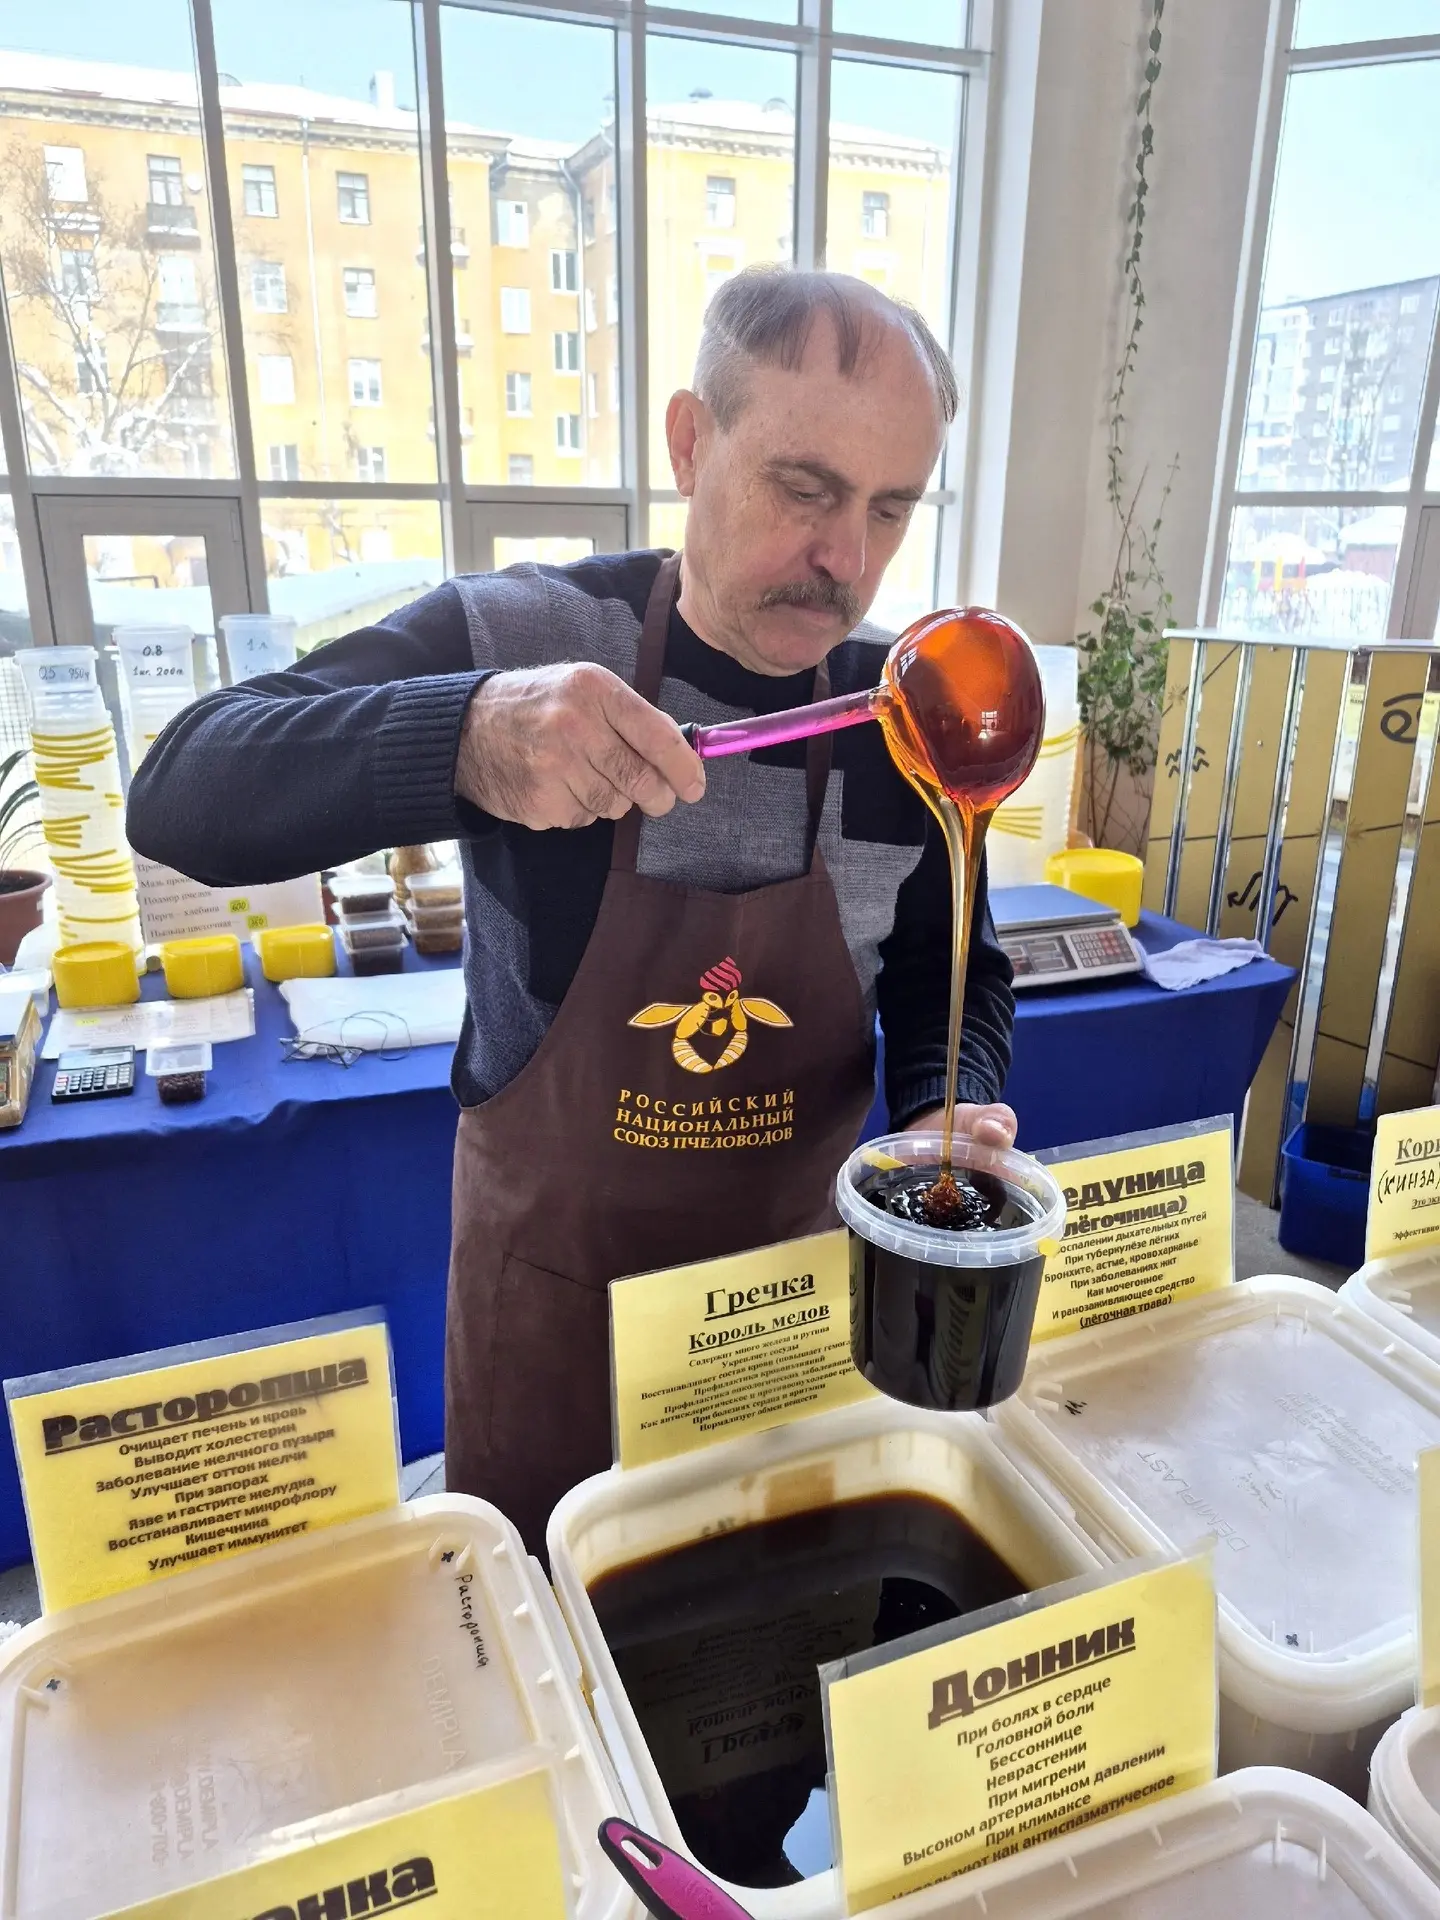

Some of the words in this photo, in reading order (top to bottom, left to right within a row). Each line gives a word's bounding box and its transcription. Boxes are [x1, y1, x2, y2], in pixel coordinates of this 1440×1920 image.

[615, 1107, 794, 1133] НАЦИОНАЛЬНЫЙ
[619, 1089, 795, 1116] РОССИЙСКИЙ
[613, 1127, 670, 1149] СОЮЗ
[672, 1126, 793, 1149] ПЧЕЛОВОДОВ
[1062, 1160, 1206, 1210] едуница
[1059, 1236, 1114, 1254] оспалении
[1115, 1221, 1179, 1243] дыхательных
[1181, 1212, 1207, 1227] путей
[1063, 1195, 1188, 1238] лёгочница)
[1393, 1225, 1440, 1241] Эффективно
[1065, 1253, 1083, 1266] При
[1086, 1240, 1147, 1261] туберкулёзе
[1149, 1232, 1180, 1246] лёгких
[1096, 1258, 1128, 1271] астме,
[1129, 1239, 1199, 1264] кровохарканье
[704, 1273, 816, 1316] Гречка
[1070, 1279, 1089, 1290] При
[1091, 1262, 1158, 1286] заболеваниях
[1160, 1256, 1177, 1267] жкт
[1087, 1287, 1104, 1298] Как
[1106, 1273, 1164, 1294] мочегонное
[1052, 1310, 1059, 1320] И
[1061, 1288, 1153, 1319] ранозаживляющее
[1154, 1275, 1195, 1296] средство
[1080, 1305, 1136, 1329] (лёгочная
[1138, 1294, 1173, 1313] трава)
[688, 1321, 766, 1351] Король
[772, 1304, 830, 1330] медов
[689, 1351, 732, 1368] Содержит
[735, 1343, 760, 1356] много
[762, 1336, 791, 1348] железа
[800, 1326, 830, 1340] рутина
[721, 1351, 768, 1368] Укрепляет
[769, 1344, 799, 1356] сосуды
[641, 1375, 717, 1400] Восстанавливает
[718, 1365, 746, 1380] состав
[748, 1359, 774, 1372] крови
[664, 1389, 730, 1414] Профилактика
[801, 1357, 852, 1377] заболеваний
[693, 1372, 759, 1397] Профилактика
[42, 1357, 368, 1452] Расторопша
[640, 1419, 659, 1430] Как
[692, 1415, 711, 1425] При
[712, 1403, 751, 1418] болезнях
[752, 1395, 780, 1409] сердца
[700, 1410, 756, 1432] Нормализует
[757, 1402, 783, 1416] обмен
[119, 1432, 188, 1456] Очищает
[192, 1420, 247, 1440] печень
[250, 1416, 260, 1426] и
[263, 1406, 307, 1425] кровь
[134, 1445, 202, 1469] Выводит
[206, 1422, 297, 1452] холестерин
[96, 1461, 201, 1492] Заболевание
[204, 1441, 279, 1468] желчного
[282, 1428, 335, 1451] пузыря
[131, 1474, 208, 1500] Улучшает
[212, 1462, 256, 1480] отток
[259, 1451, 307, 1470] желчи
[129, 1514, 164, 1531] Язве
[167, 1510, 177, 1520] и
[180, 1495, 246, 1518] гастрите
[249, 1477, 315, 1503] желудка
[174, 1489, 204, 1504] При
[207, 1473, 269, 1497] запорах
[108, 1511, 241, 1551] Восстанавливает
[245, 1485, 337, 1517] микрофлору
[185, 1518, 269, 1545] Кишечника
[148, 1543, 224, 1571] Улучшает
[227, 1521, 308, 1551] иммунитет
[927, 1617, 1136, 1731] Донник
[957, 1727, 988, 1747] При
[991, 1706, 1039, 1733] болях
[1043, 1700, 1052, 1712] в
[1055, 1676, 1112, 1707] сердце
[976, 1716, 1053, 1759] Головной
[1056, 1701, 1095, 1725] боли
[986, 1741, 1087, 1792] Неврастении
[989, 1724, 1083, 1772] Бессоннице
[902, 1824, 975, 1867] Высоком
[979, 1777, 1090, 1834] артериальном
[1093, 1744, 1166, 1784] давлении
[988, 1791, 1018, 1810] При
[1021, 1760, 1087, 1796] мигрени
[985, 1826, 1015, 1848] При
[1018, 1794, 1092, 1833] климаксе
[992, 1841, 1019, 1863] как
[1022, 1774, 1175, 1850] антиспазматическое
